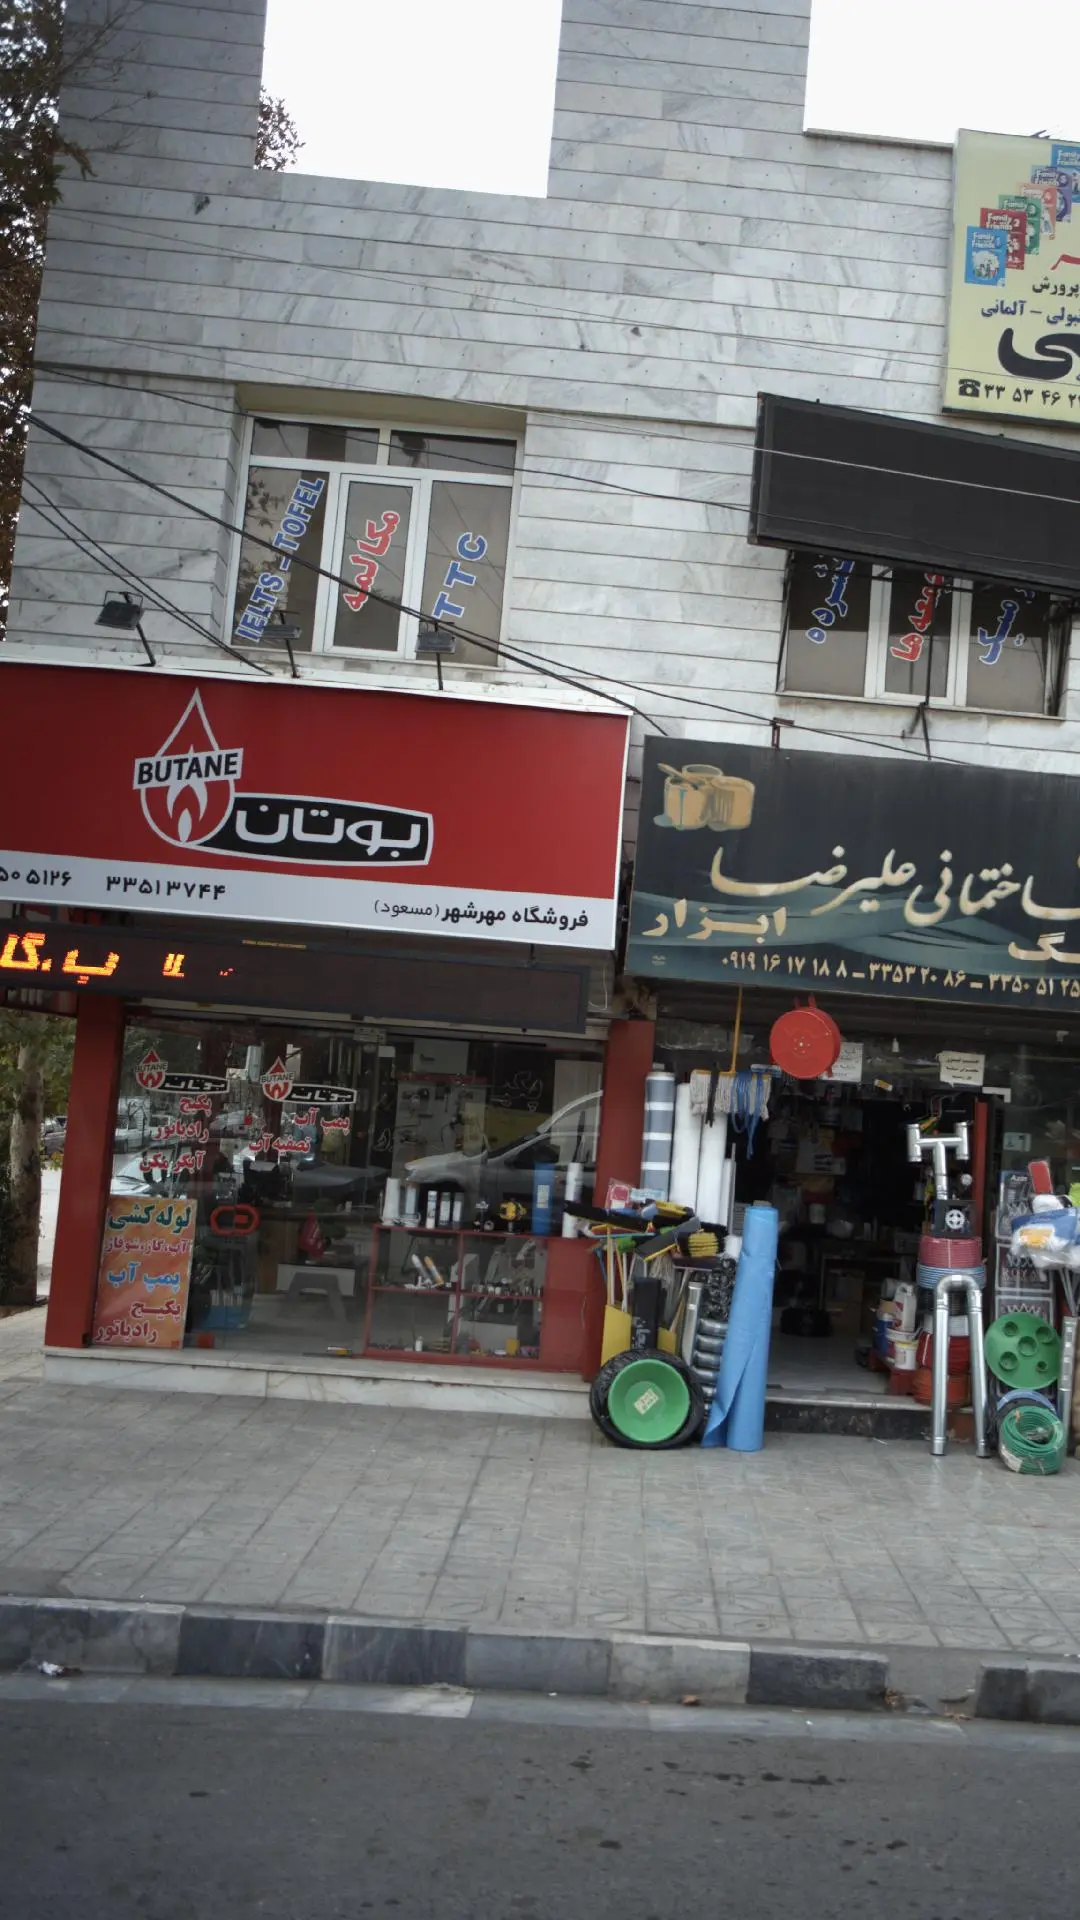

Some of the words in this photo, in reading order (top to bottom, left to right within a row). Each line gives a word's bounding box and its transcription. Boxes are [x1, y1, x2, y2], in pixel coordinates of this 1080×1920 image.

[1013, 218, 1021, 228] 2
[981, 299, 1028, 318] آلمانی
[235, 572, 285, 644] IELTS
[272, 478, 326, 552] TOFEL
[135, 752, 240, 787] BUTANE
[234, 803, 422, 860] بوتان
[441, 901, 507, 926] مهرشهر
[512, 906, 589, 931] فروشگاه
[642, 898, 788, 944] ابزار
[260, 1072, 295, 1084] BUTANE
[294, 1107, 320, 1129] آب
[248, 1131, 274, 1153] آب
[107, 1261, 141, 1288] آب
[142, 1271, 181, 1295] پمپ
[130, 1299, 181, 1323] پکیج
[95, 1319, 159, 1344] رادیاتور
